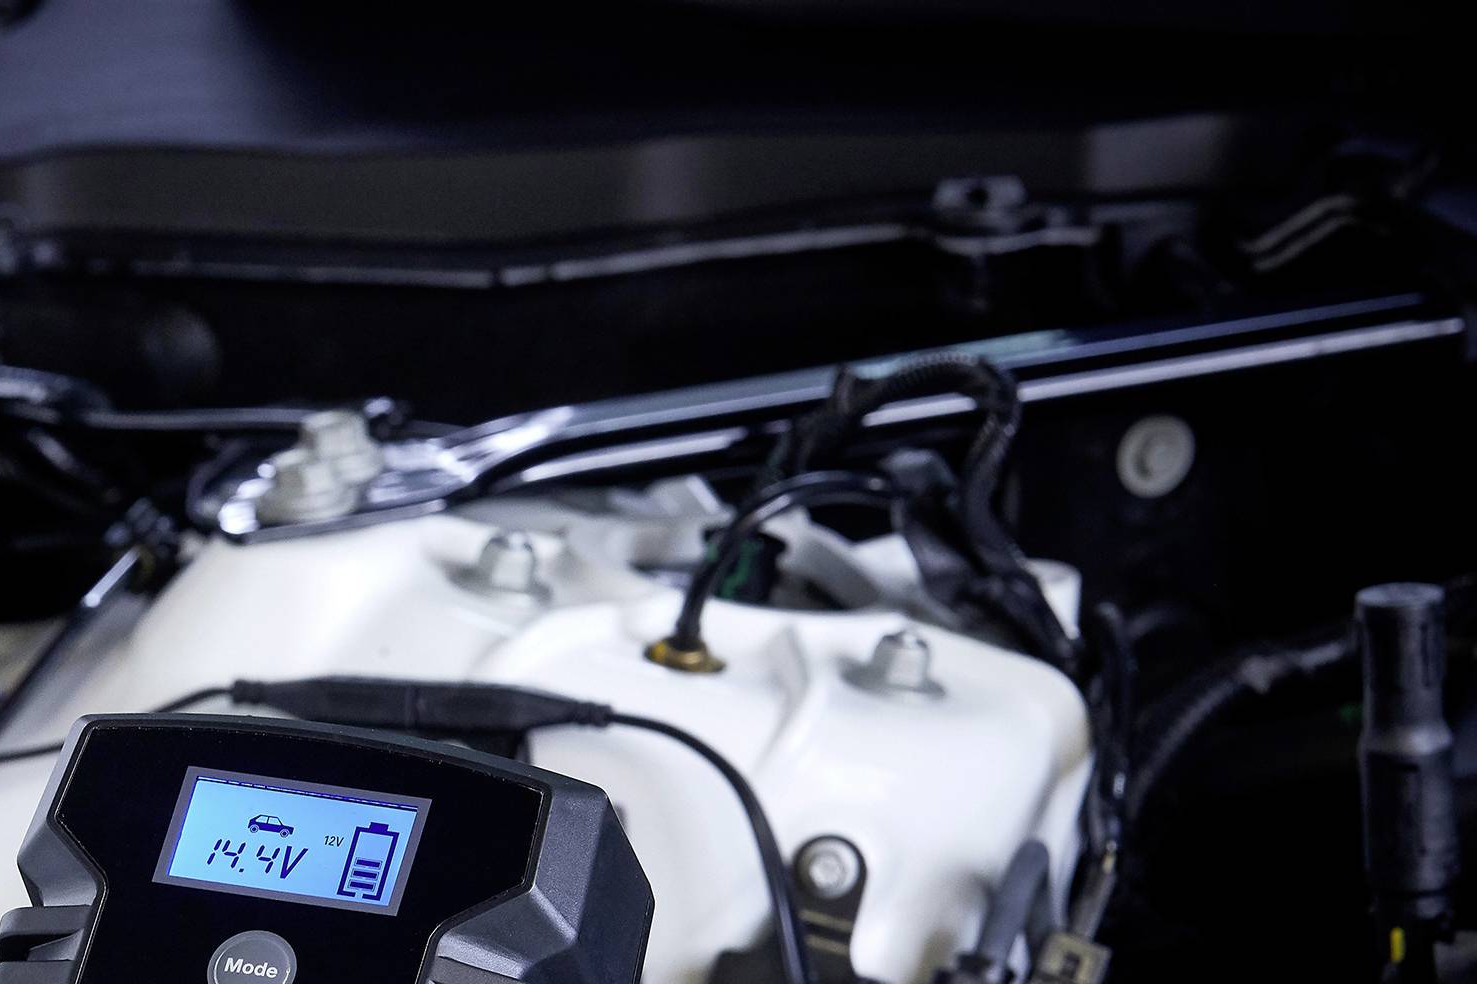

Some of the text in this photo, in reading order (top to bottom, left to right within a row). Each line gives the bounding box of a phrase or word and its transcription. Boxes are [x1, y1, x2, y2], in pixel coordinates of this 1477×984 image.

[323, 834, 345, 848] 12V
[206, 838, 309, 880] 14.4V
[224, 957, 279, 979] Mode
